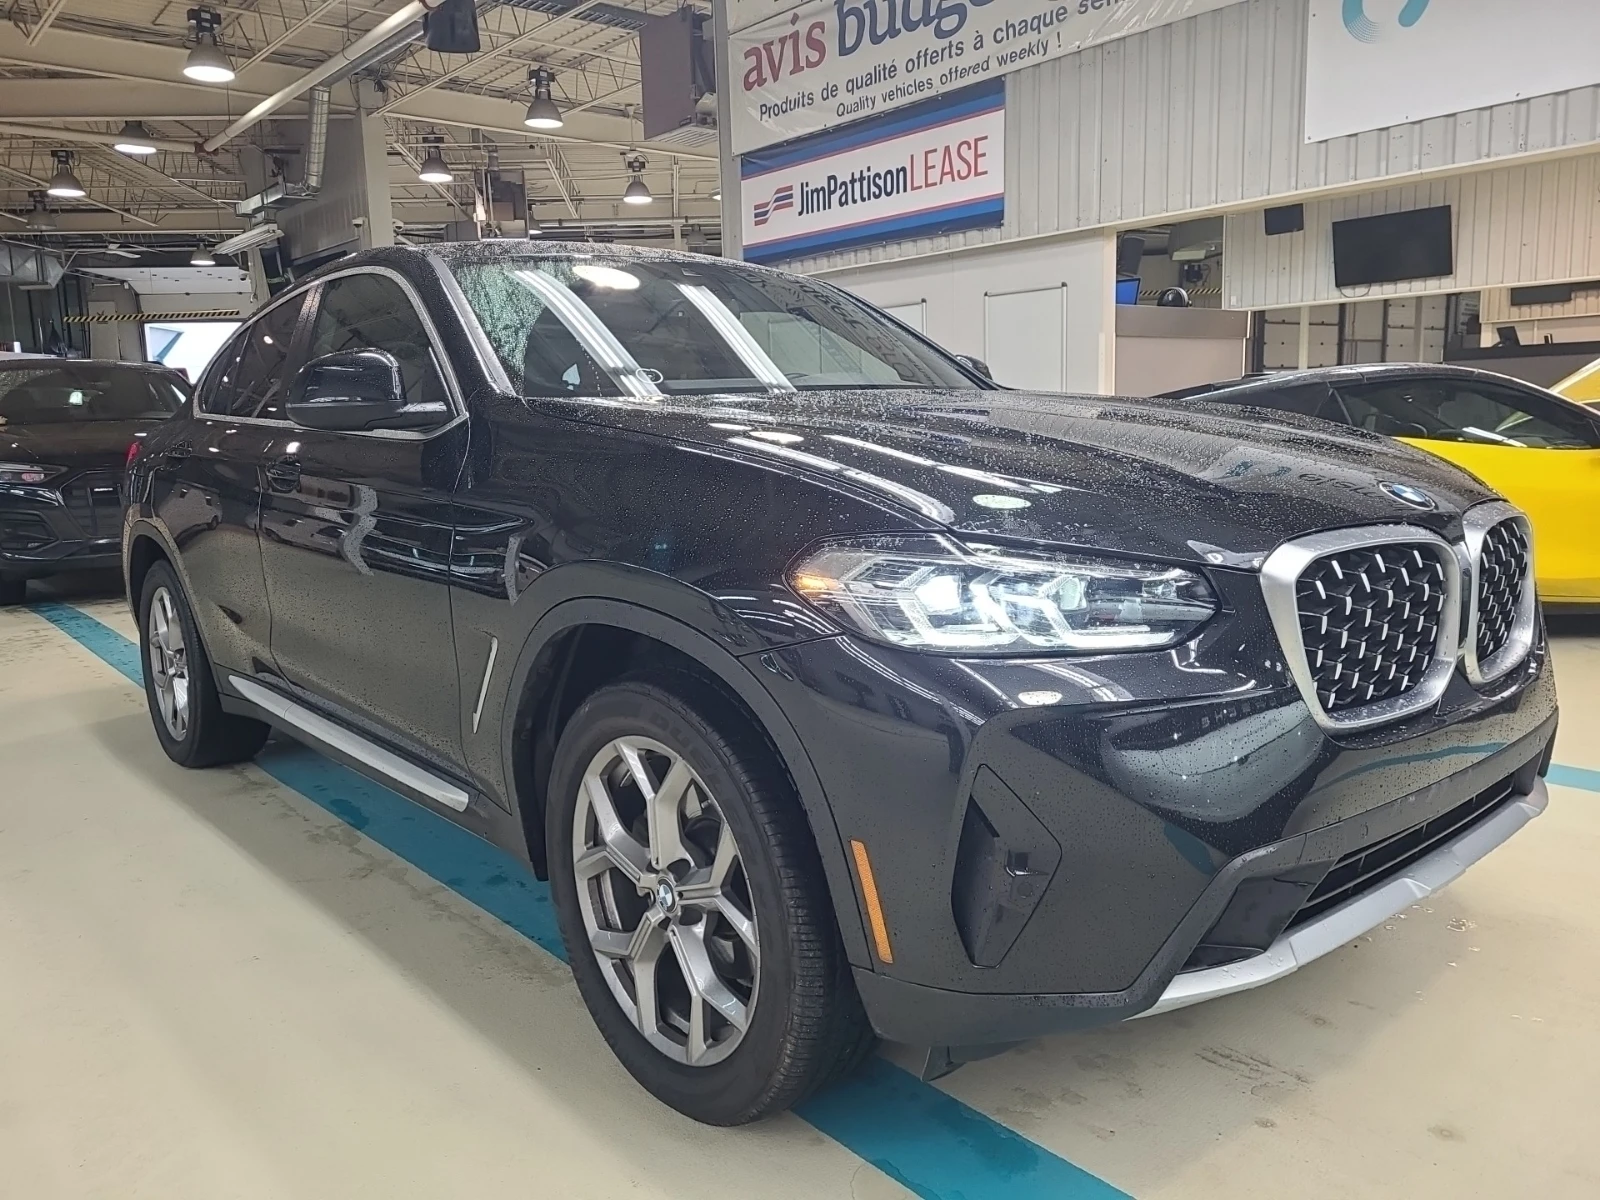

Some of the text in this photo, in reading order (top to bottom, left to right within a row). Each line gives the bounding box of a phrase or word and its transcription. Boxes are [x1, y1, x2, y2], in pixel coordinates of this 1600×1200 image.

[743, 0, 994, 92] avis budg
[759, 0, 1125, 121] Produits de qualité offerts à chaque se
[836, 95, 876, 117] Quality
[881, 76, 934, 104] vehicles
[940, 55, 990, 86] offered
[996, 37, 1049, 68] weekly
